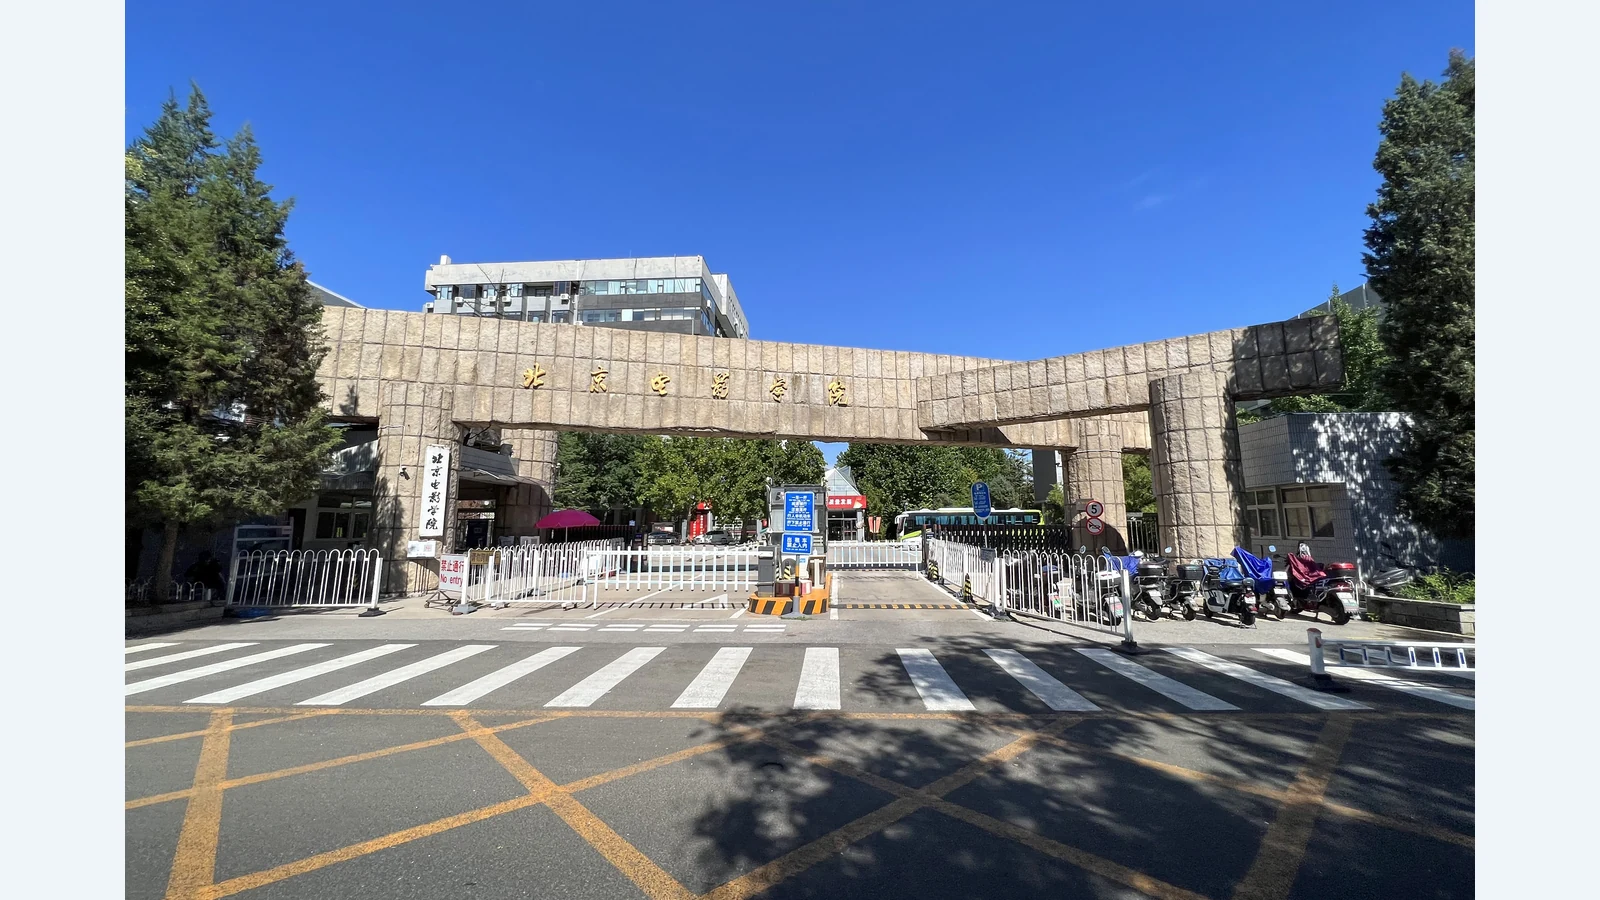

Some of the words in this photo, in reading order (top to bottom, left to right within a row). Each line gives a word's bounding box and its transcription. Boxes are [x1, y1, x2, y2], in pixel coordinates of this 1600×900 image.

[523, 362, 848, 407] 北京电影学院
[425, 453, 443, 530] 北京电影学院
[1091, 504, 1098, 514] 5
[441, 559, 465, 573] 禁止通行
[440, 574, 448, 583] No
[449, 575, 463, 588] entry
